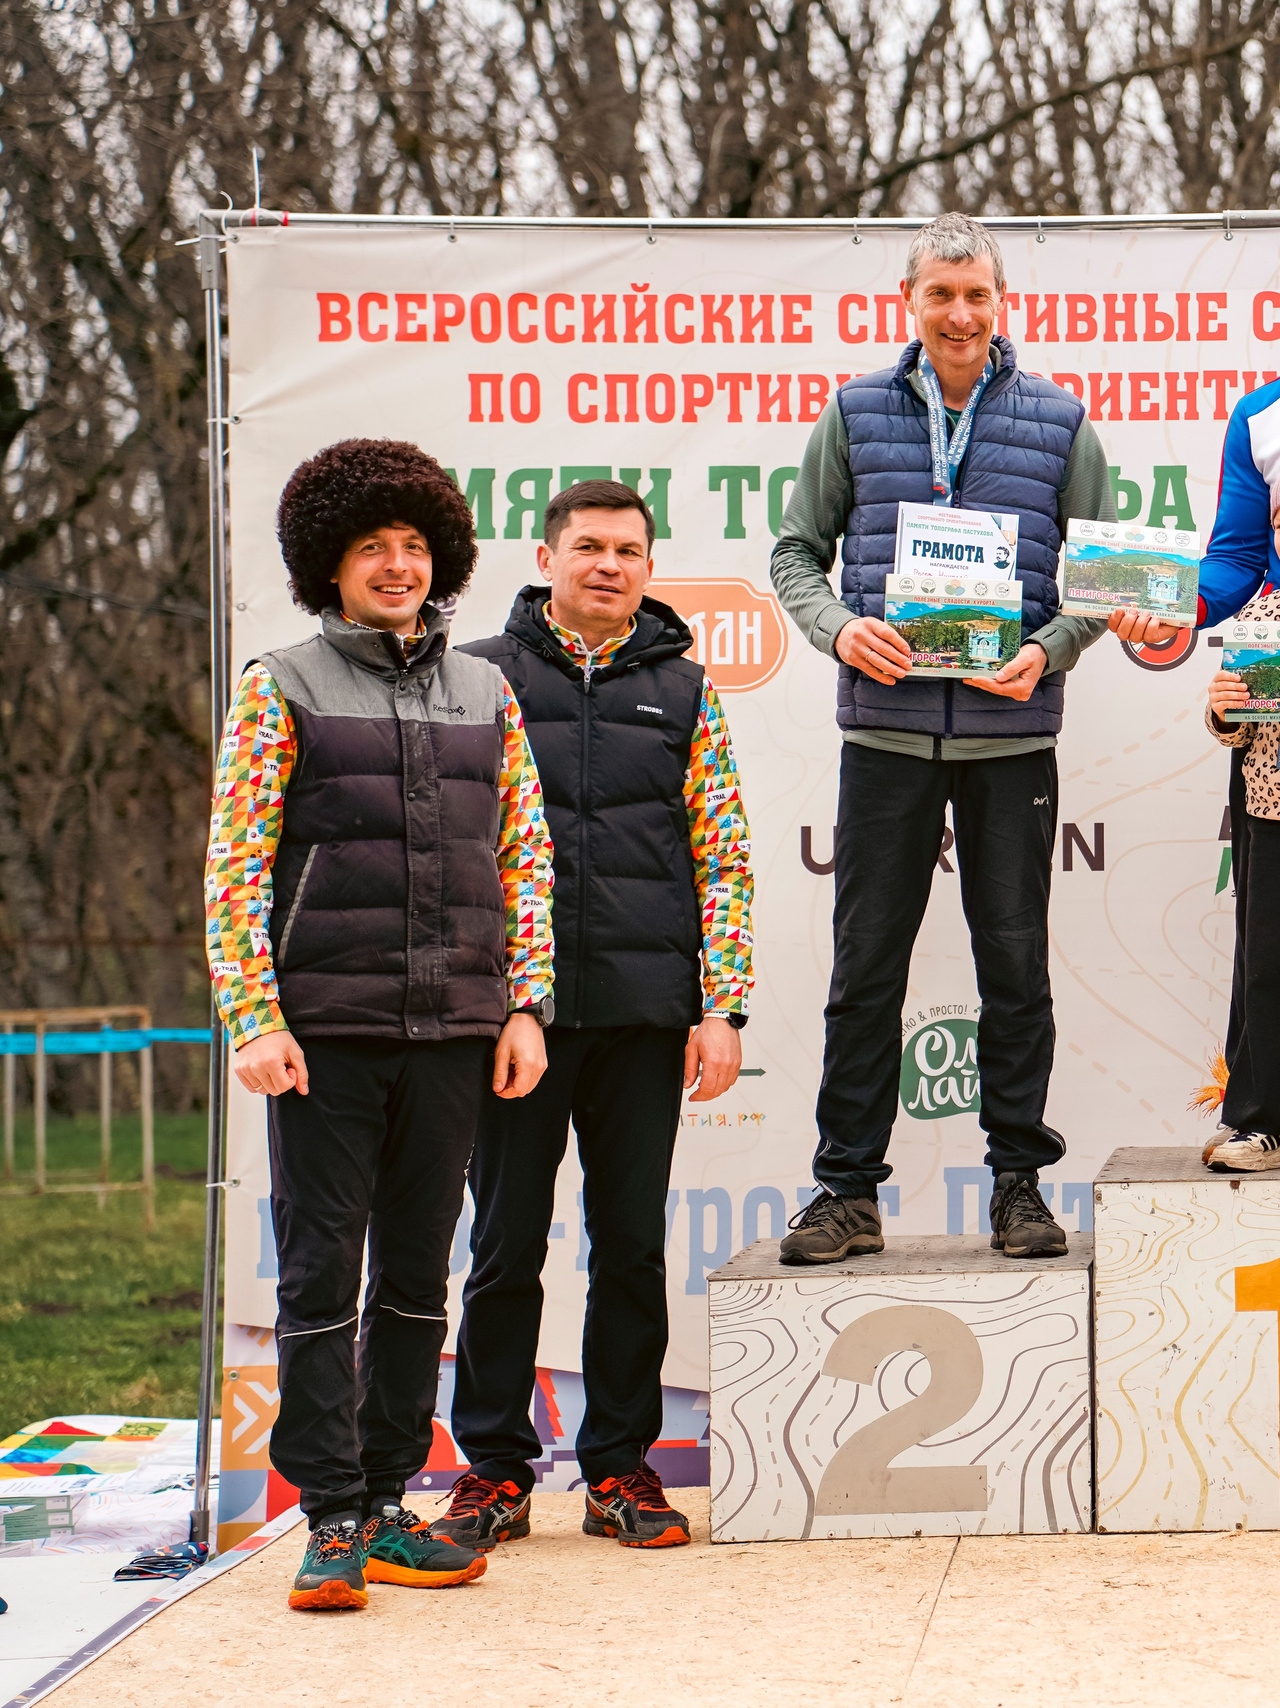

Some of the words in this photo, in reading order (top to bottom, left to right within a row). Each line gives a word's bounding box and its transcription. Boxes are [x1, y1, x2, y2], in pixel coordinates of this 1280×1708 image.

[317, 283, 813, 344] ВСЕРОССИЙСКИЕ
[837, 292, 1228, 344] СПТИВНЫЕ
[468, 373, 541, 424] ПО
[912, 539, 985, 563] ГРАМОТА
[1067, 588, 1120, 601] ПЯТИГОРСК
[918, 1010, 927, 1022] &
[929, 1004, 968, 1017] ПРОСТО!
[814, 1305, 987, 1515] 2
